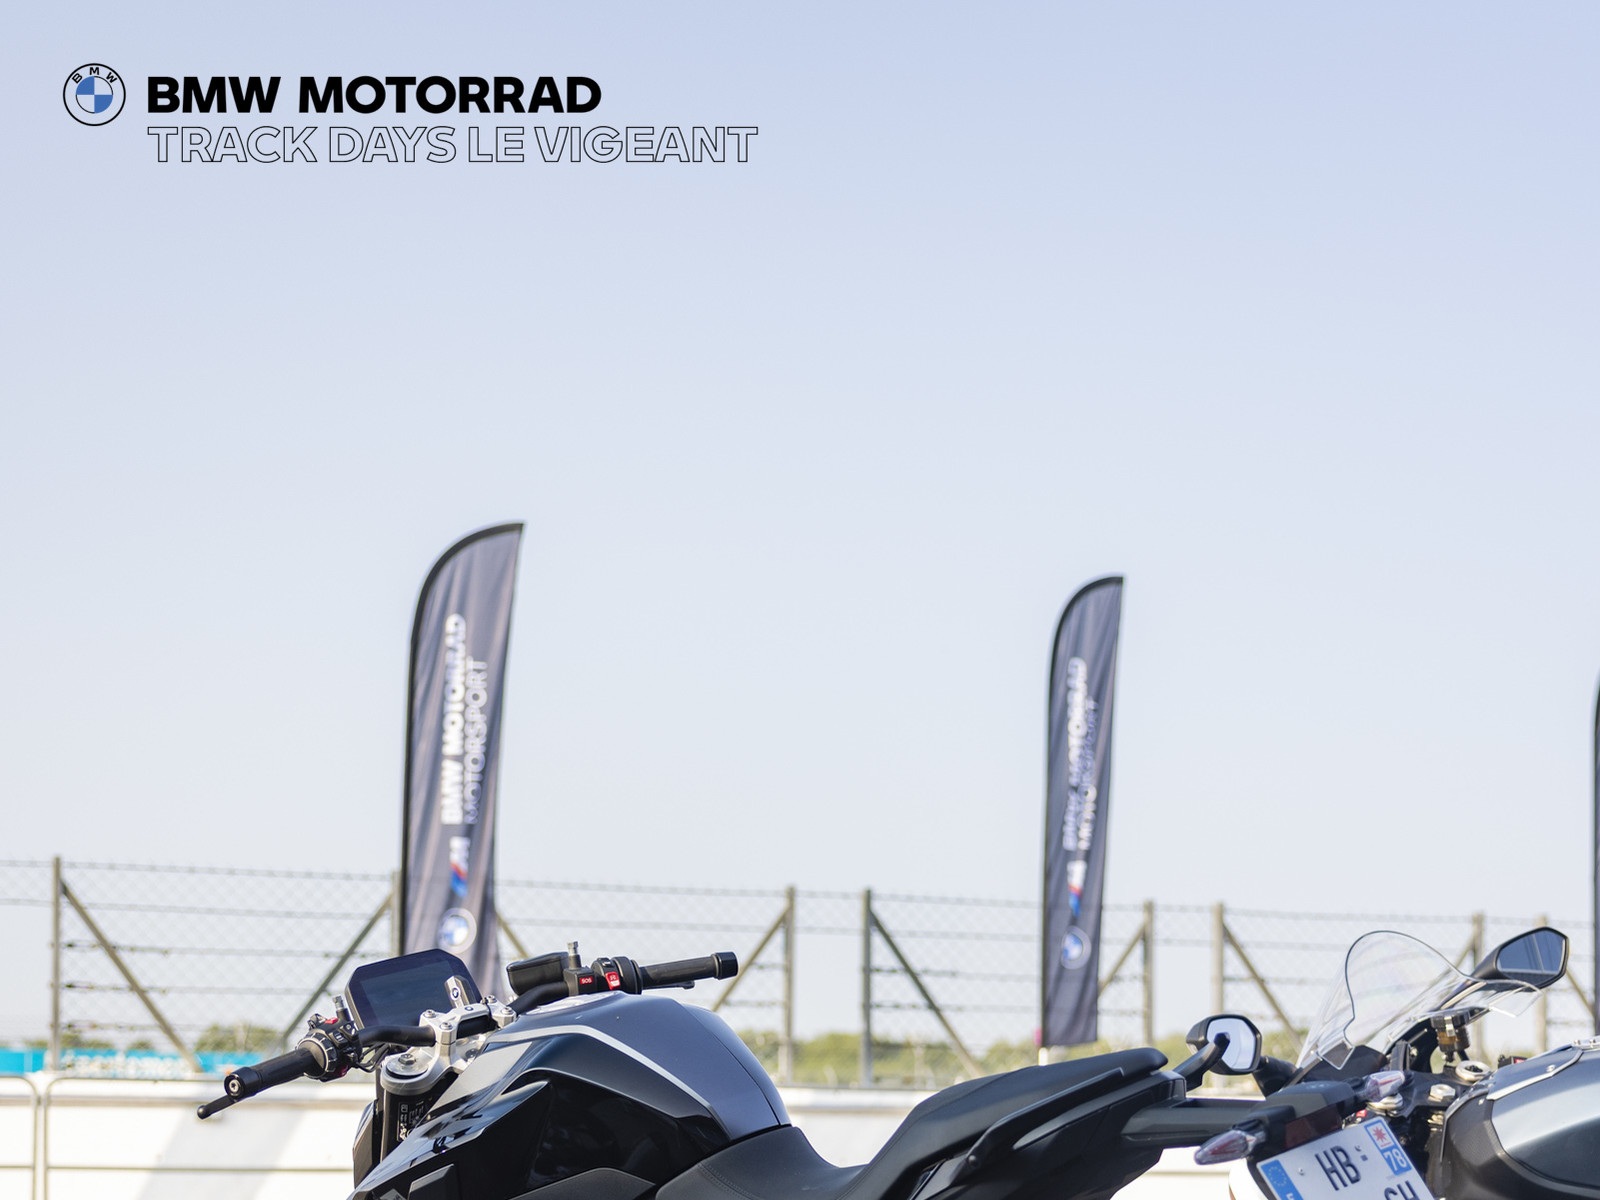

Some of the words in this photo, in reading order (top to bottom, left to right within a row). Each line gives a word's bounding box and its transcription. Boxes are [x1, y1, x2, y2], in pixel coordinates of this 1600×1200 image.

[464, 656, 488, 825] MOTORSPORT
[441, 758, 464, 825] BMW
[1383, 1147, 1408, 1172] 78
